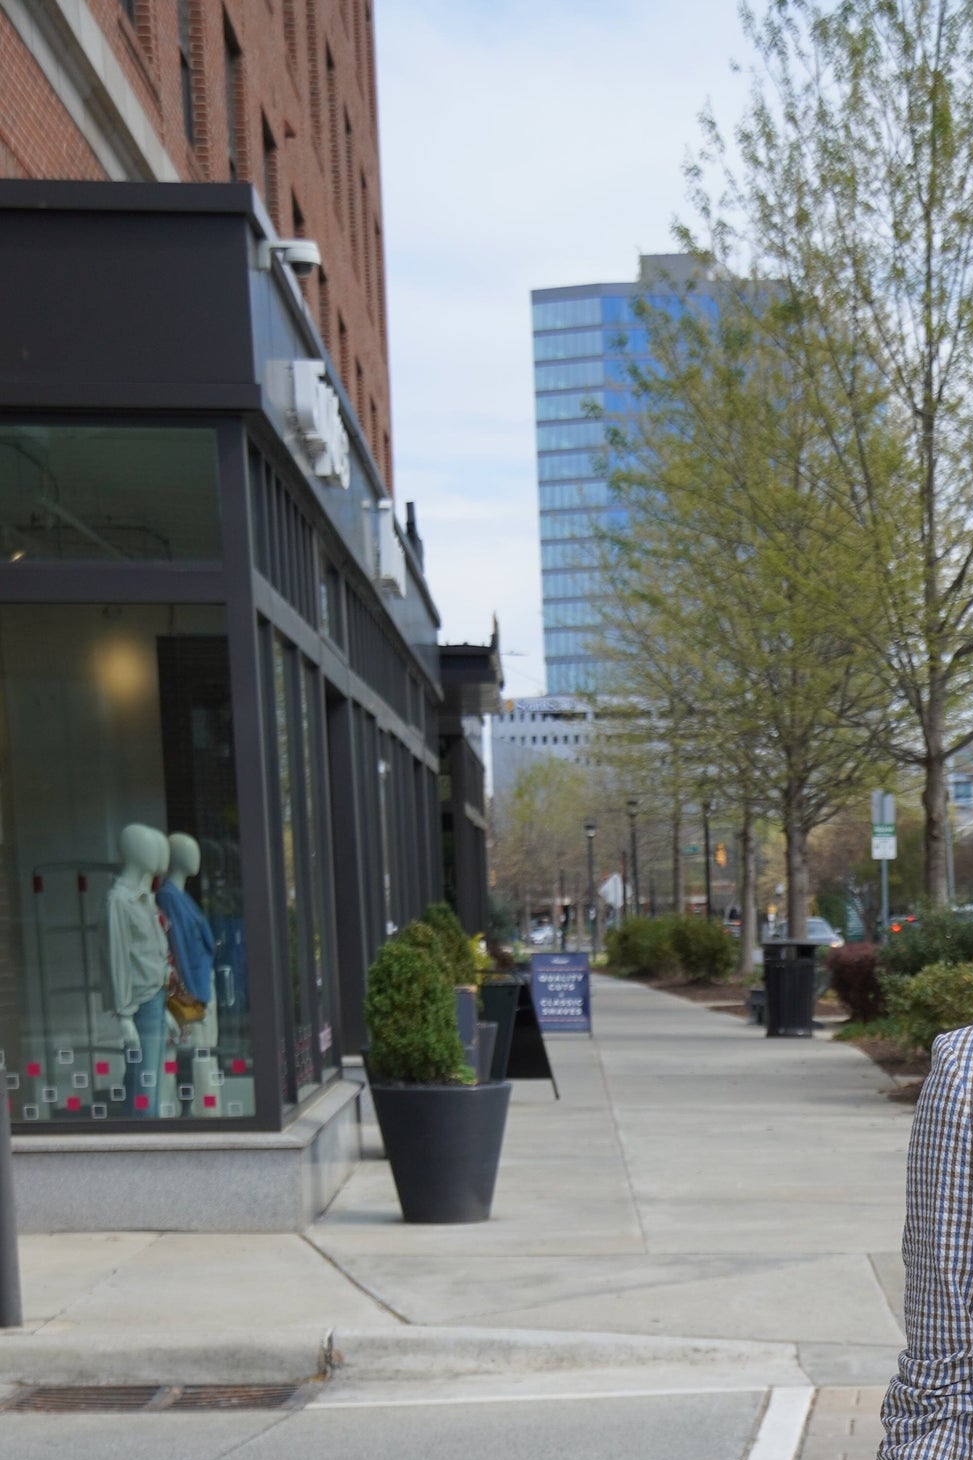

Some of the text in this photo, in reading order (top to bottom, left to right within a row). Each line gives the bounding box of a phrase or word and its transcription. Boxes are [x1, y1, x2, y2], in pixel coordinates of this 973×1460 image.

[538, 972, 584, 982] QUALITY
[547, 983, 576, 992] CUTS
[540, 998, 584, 1007] CLASSIC
[541, 1007, 583, 1016] SHAVES
